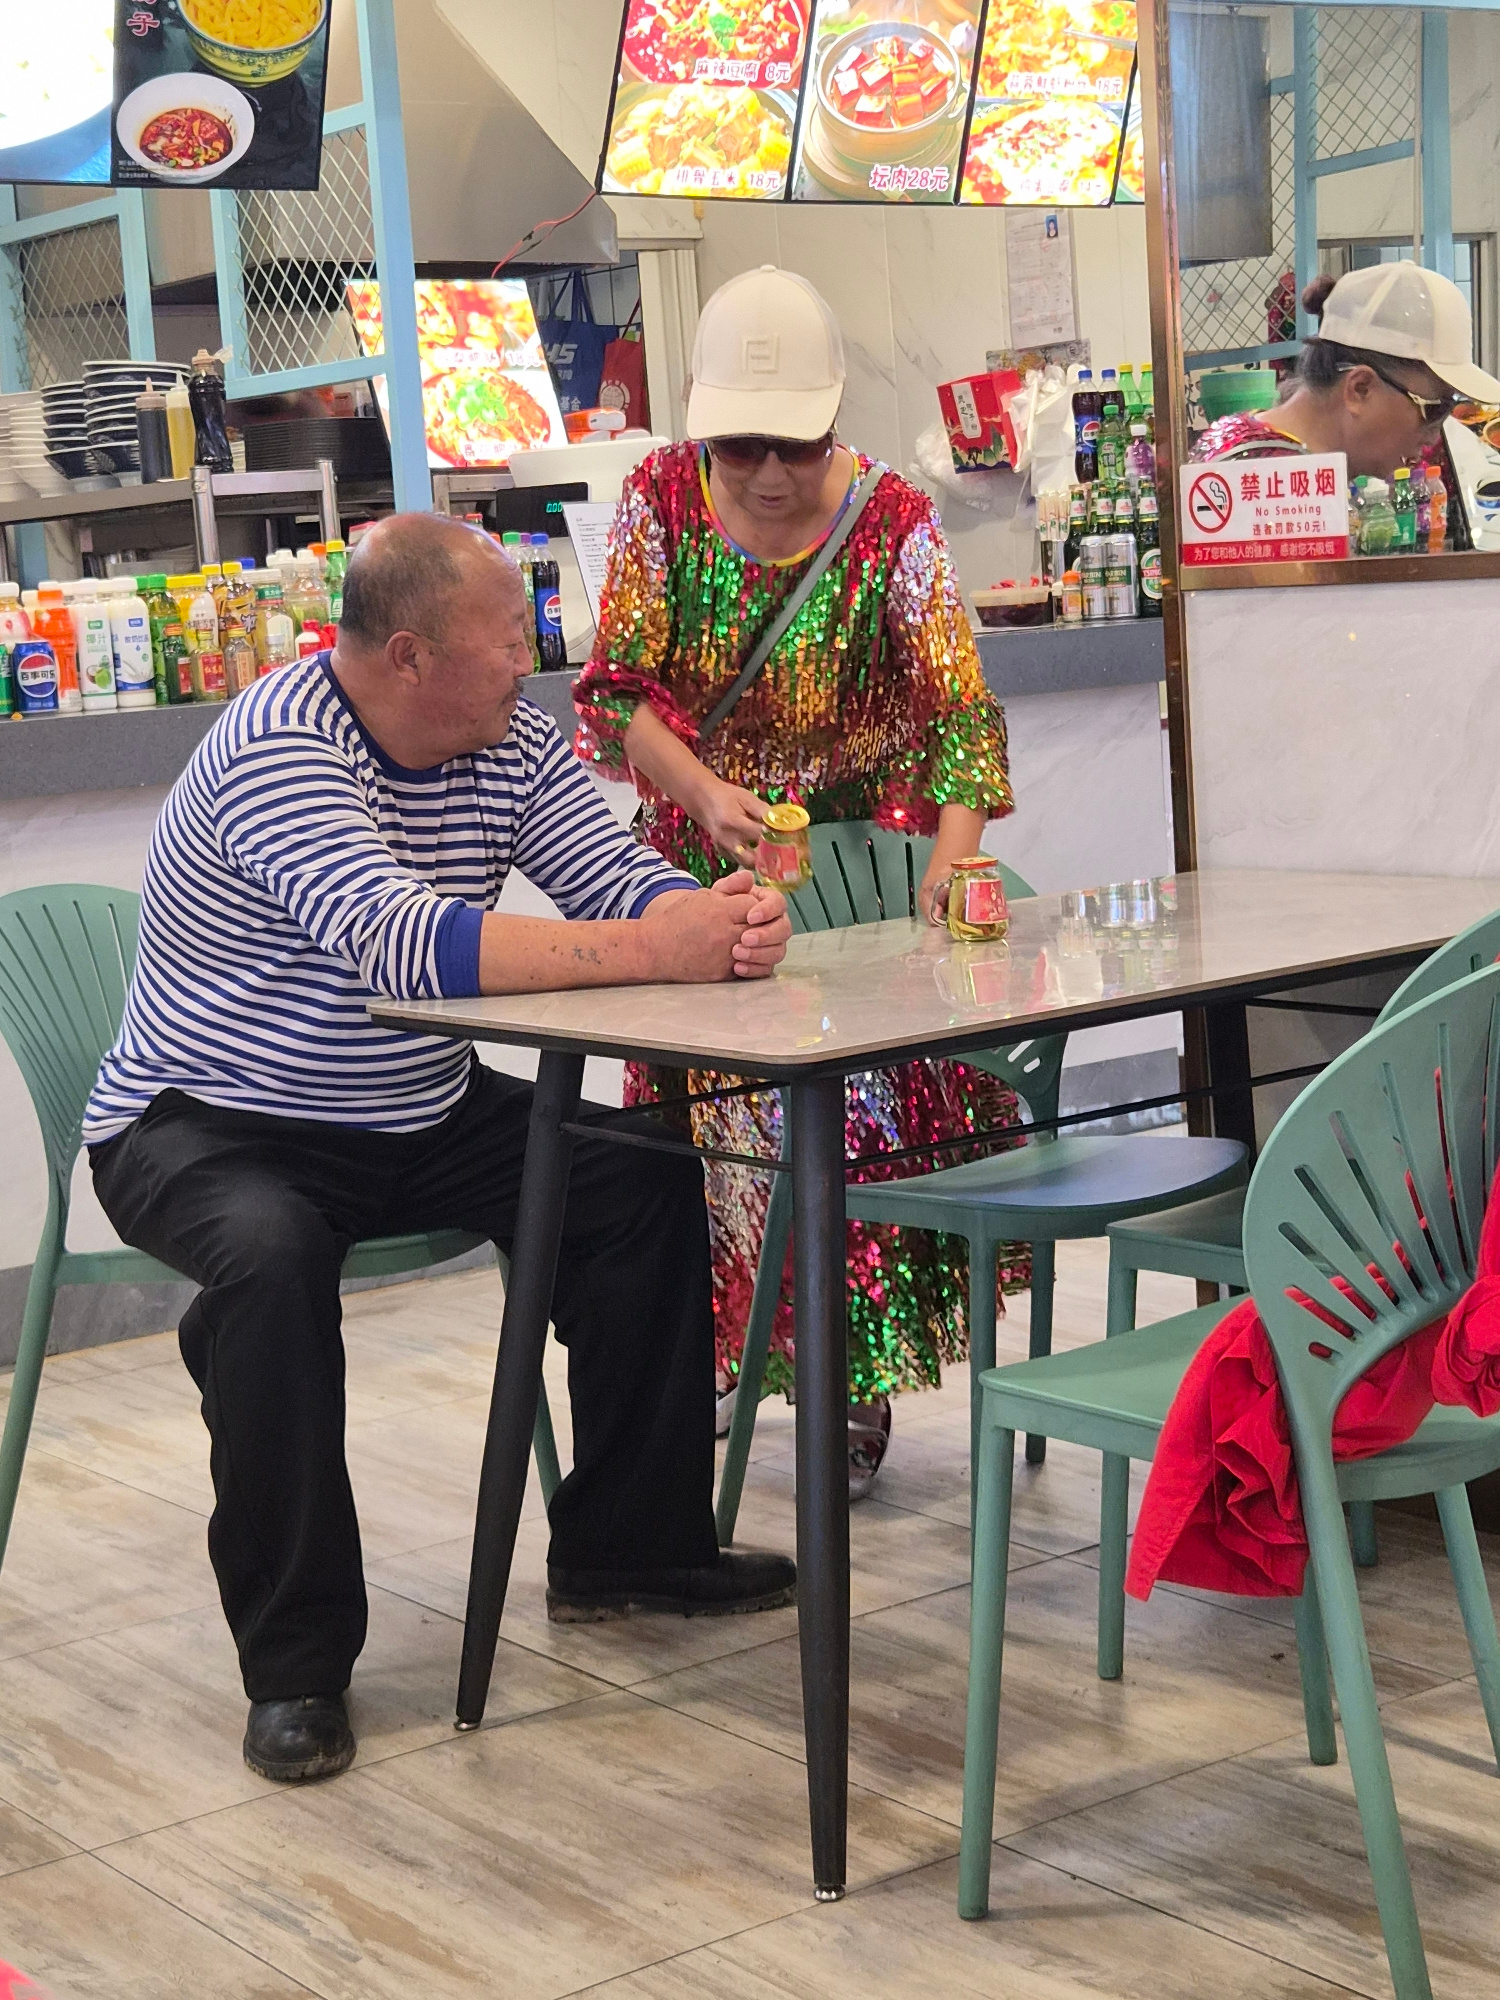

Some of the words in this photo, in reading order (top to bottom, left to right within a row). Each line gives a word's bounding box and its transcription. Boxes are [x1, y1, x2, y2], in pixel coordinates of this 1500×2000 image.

[126, 0, 160, 36] 子
[695, 60, 758, 79] 麻辣豆腐
[767, 63, 790, 81] 8元
[1098, 78, 1122, 95] 18元
[750, 172, 779, 189] 18元
[870, 166, 948, 190] 坛肉28元
[1240, 468, 1336, 501] 禁止吸烟
[1255, 507, 1269, 517] No
[1275, 504, 1322, 516] Smoking
[1252, 521, 1326, 536] 违者罚款50元!
[21, 669, 56, 681] 百事可乐
